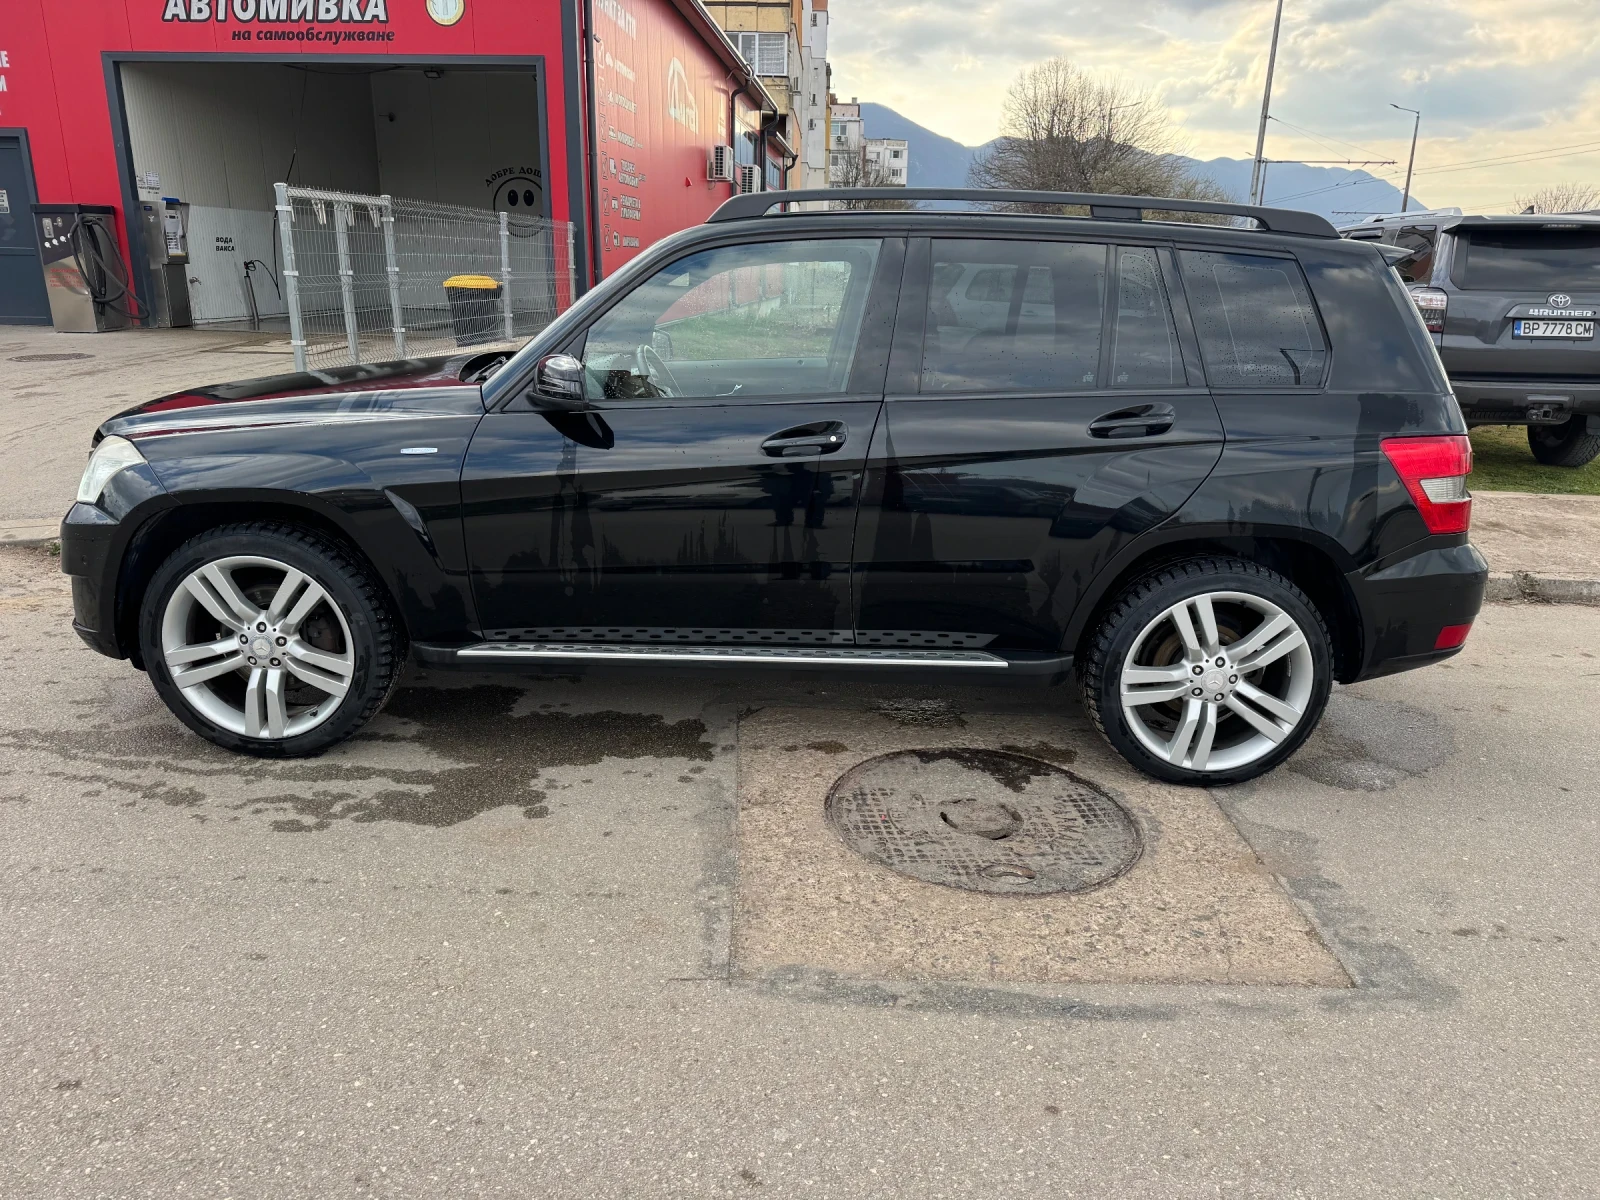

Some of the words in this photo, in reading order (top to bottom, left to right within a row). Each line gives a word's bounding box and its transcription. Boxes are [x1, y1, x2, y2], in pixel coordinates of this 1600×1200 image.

[231, 30, 252, 41] на
[256, 27, 395, 45] самообслужване
[485, 167, 515, 187] ДОБРЕ
[1542, 322, 1573, 335] 7778
